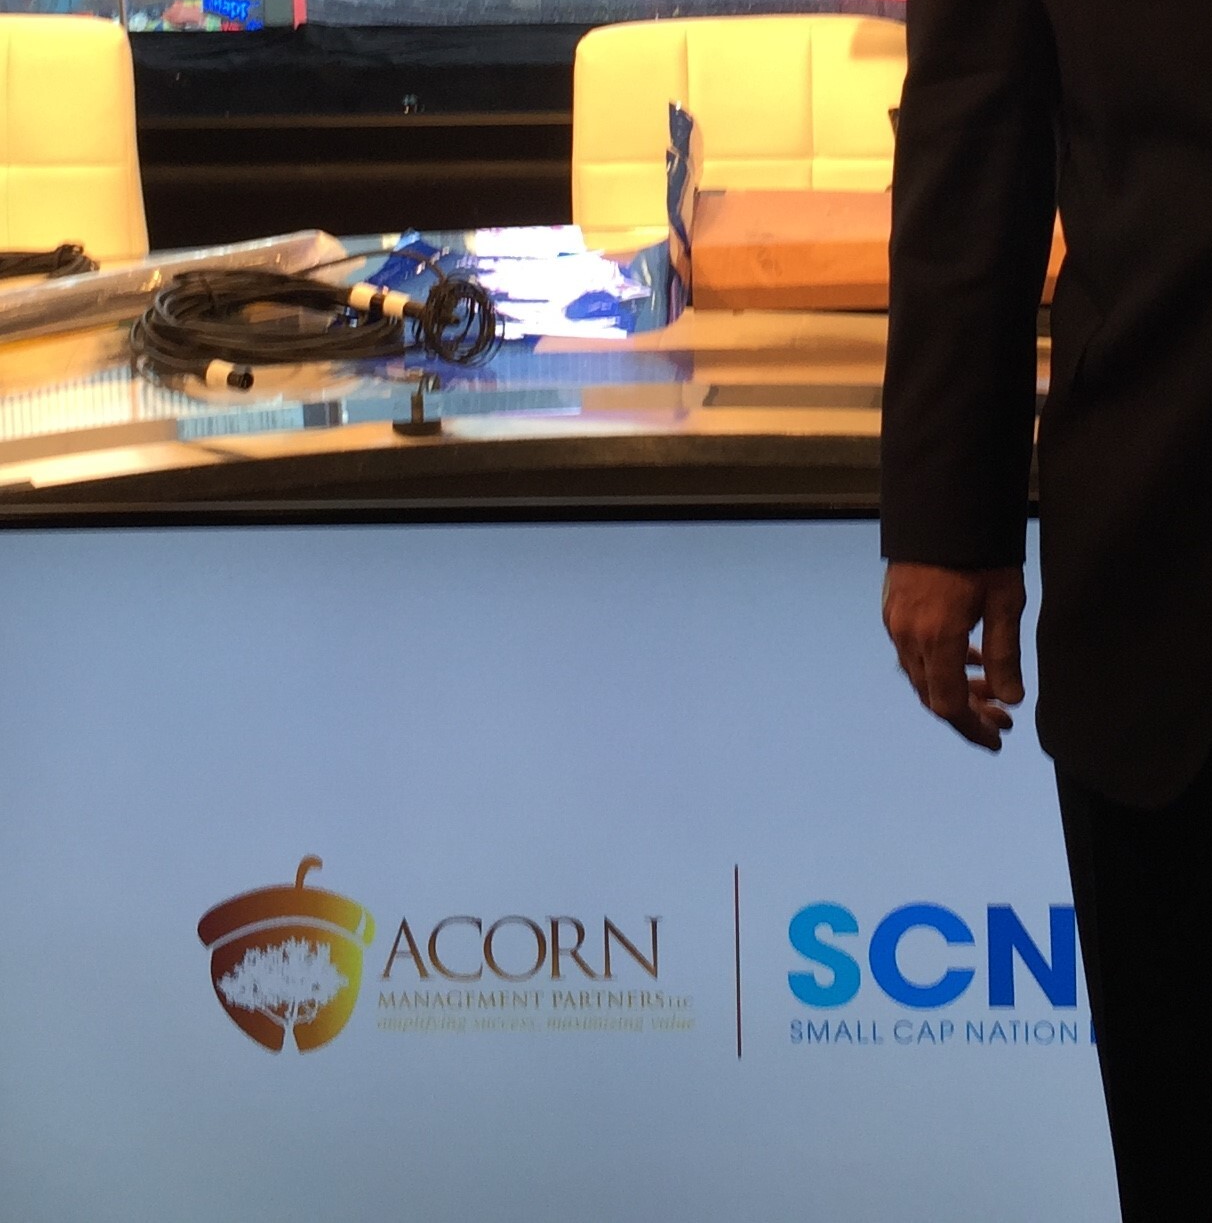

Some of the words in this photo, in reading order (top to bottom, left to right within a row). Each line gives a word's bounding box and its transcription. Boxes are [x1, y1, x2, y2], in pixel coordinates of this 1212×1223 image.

[379, 914, 663, 983] ACORN
[787, 899, 1078, 1012] SCN
[377, 989, 545, 1010] MANAGEMENT
[551, 989, 665, 1010] PARTNERS
[790, 1018, 884, 1045] SMALL
[893, 1018, 955, 1045] CAP
[965, 1018, 1079, 1045] NATION
